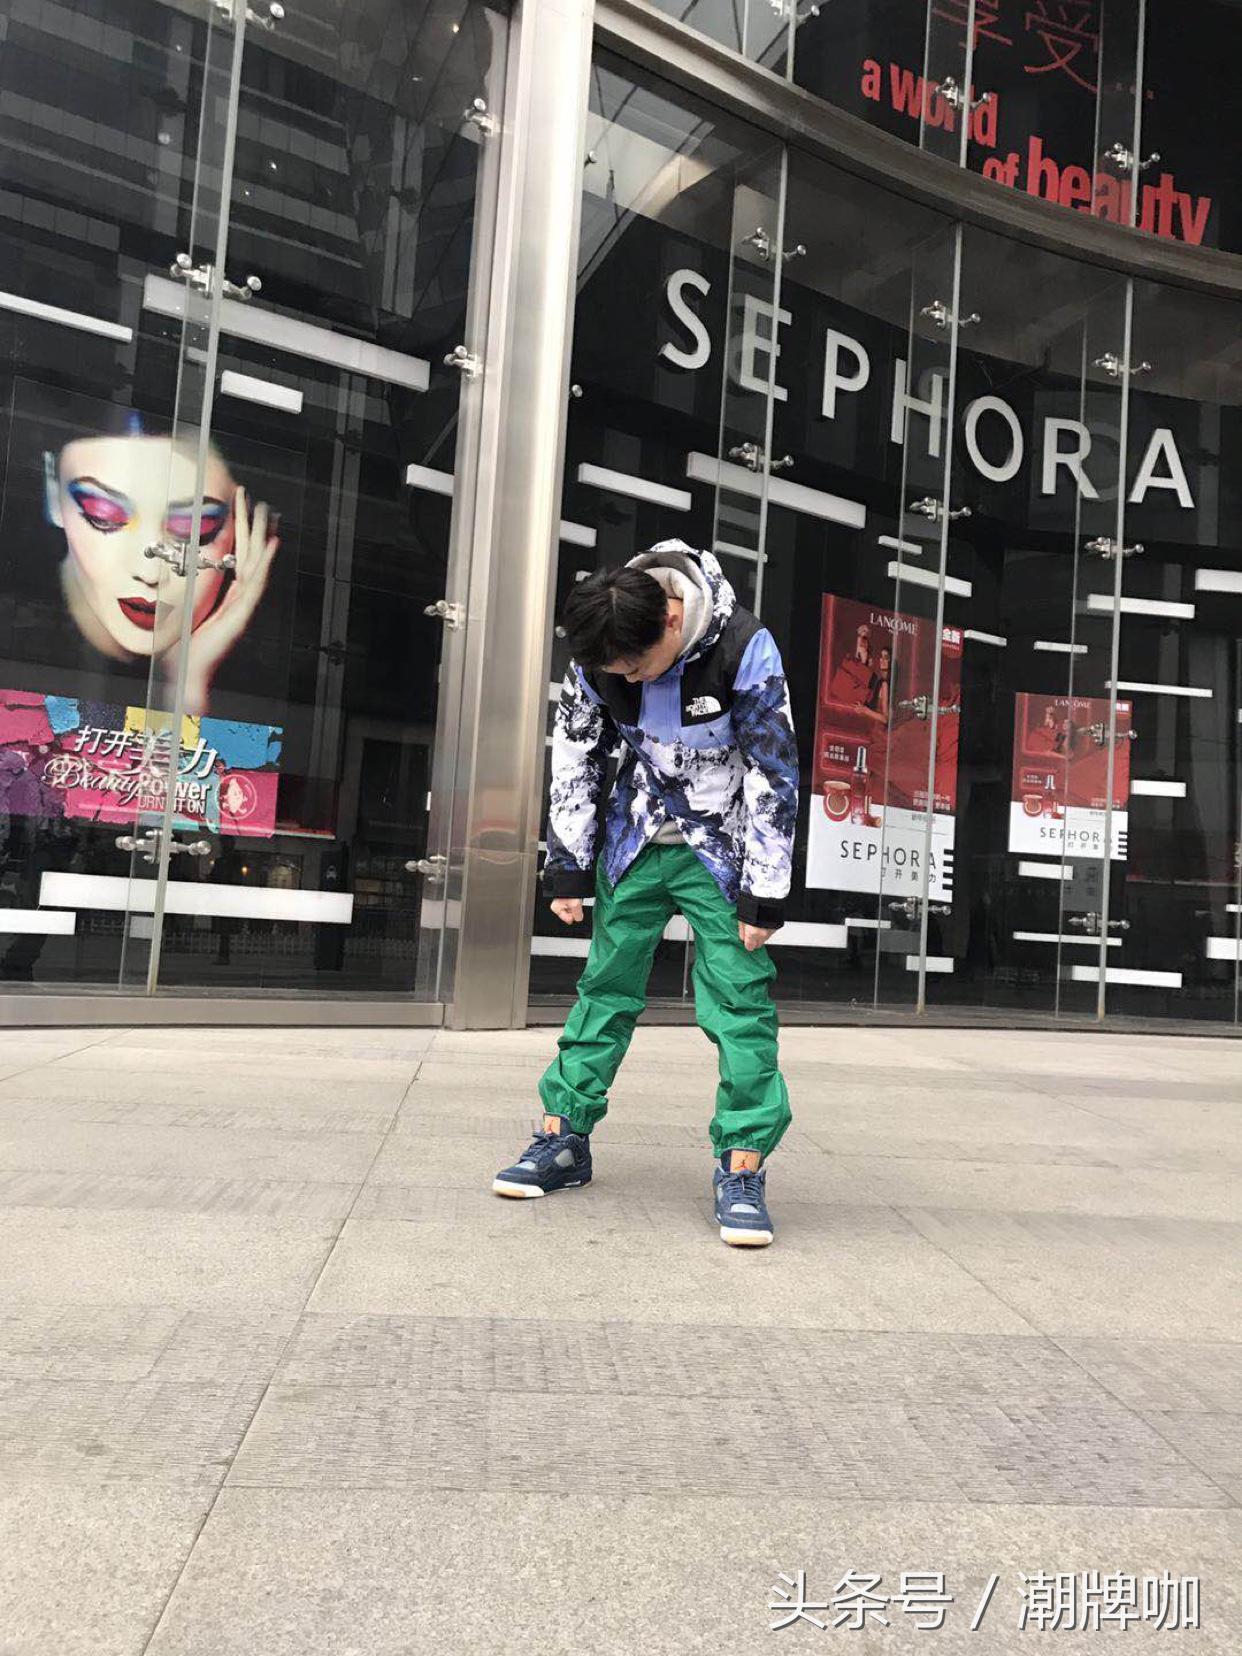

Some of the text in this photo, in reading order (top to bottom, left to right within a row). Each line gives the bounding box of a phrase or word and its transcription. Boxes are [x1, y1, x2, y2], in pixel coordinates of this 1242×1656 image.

[861, 58, 880, 101] a
[1027, 135, 1212, 246] beauty
[660, 267, 1196, 509] SEPHORA
[1055, 699, 1091, 710] LANOME
[74, 724, 218, 779] 打开美力
[1040, 826, 1112, 844] SEPHOR
